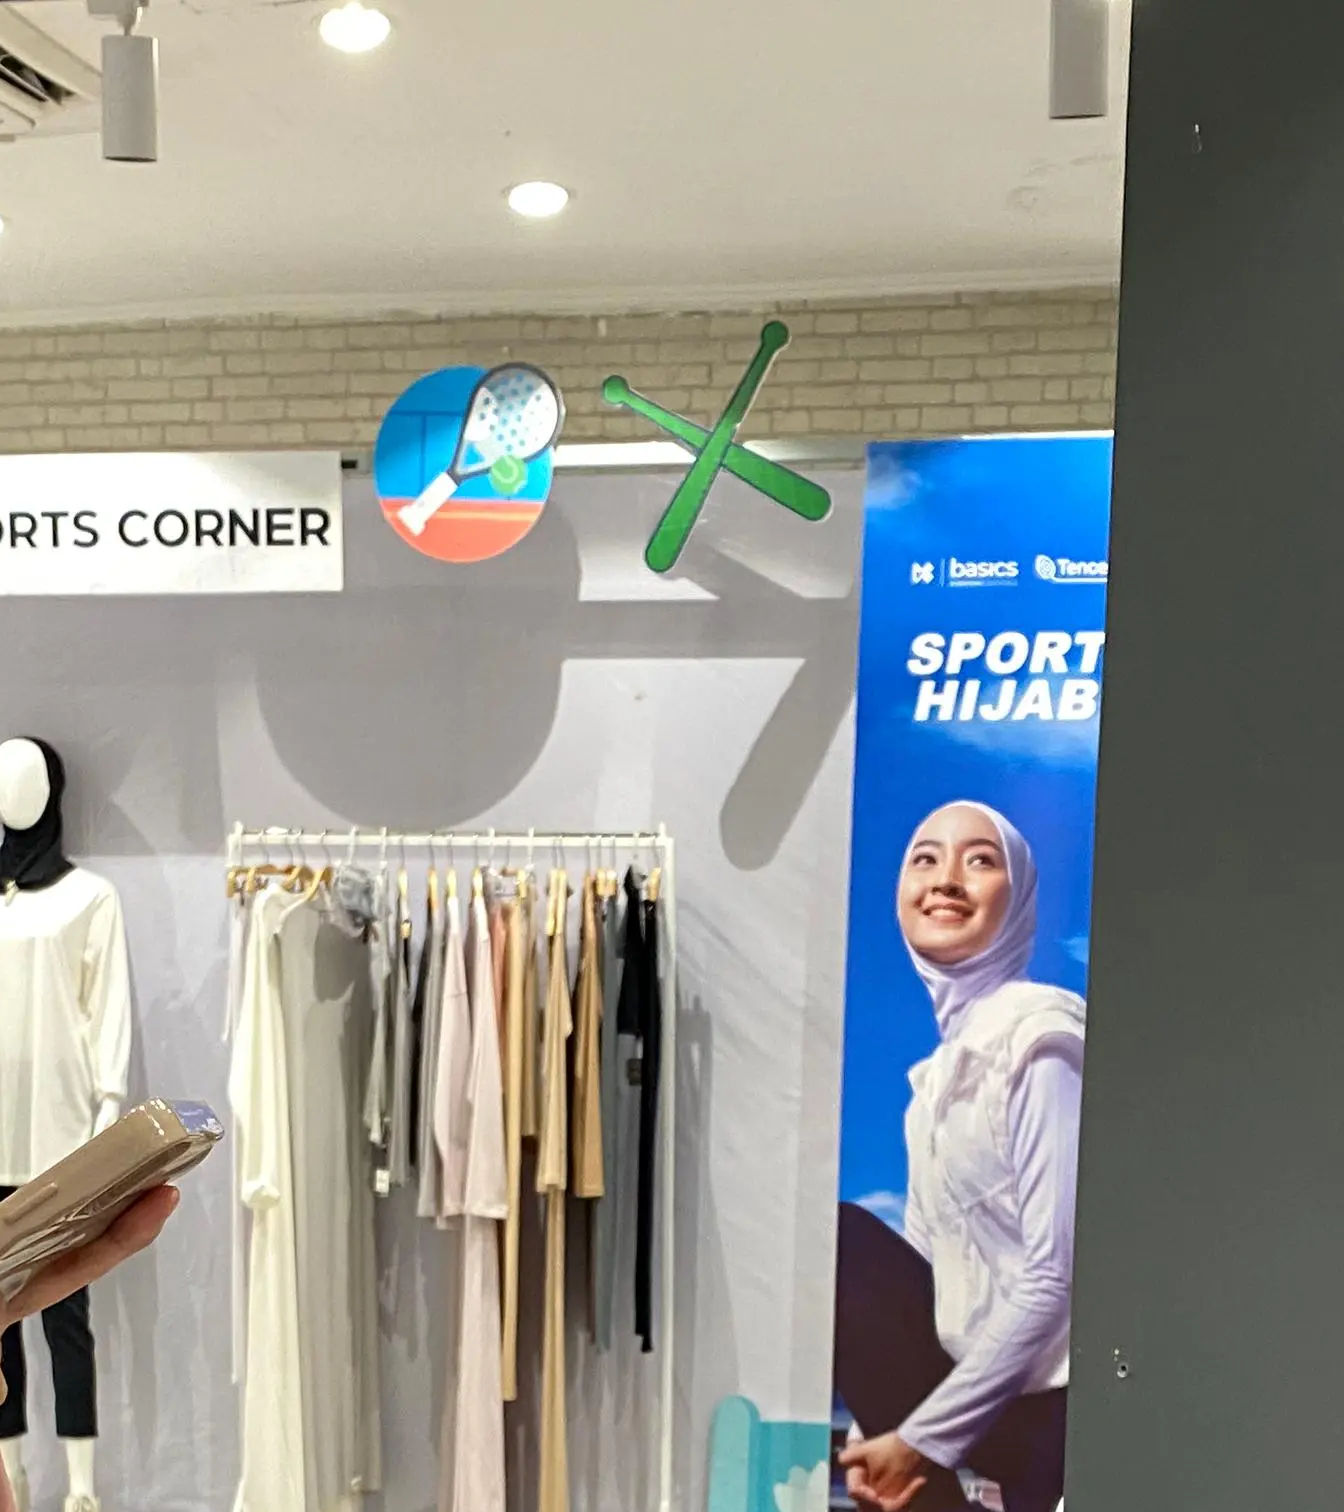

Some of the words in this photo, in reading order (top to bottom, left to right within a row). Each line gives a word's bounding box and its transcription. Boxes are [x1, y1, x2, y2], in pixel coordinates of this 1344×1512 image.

[117, 507, 331, 547] CORNER
[950, 557, 1019, 579] basics
[907, 632, 1106, 676] SPORT
[913, 679, 1100, 722] HIJAB
